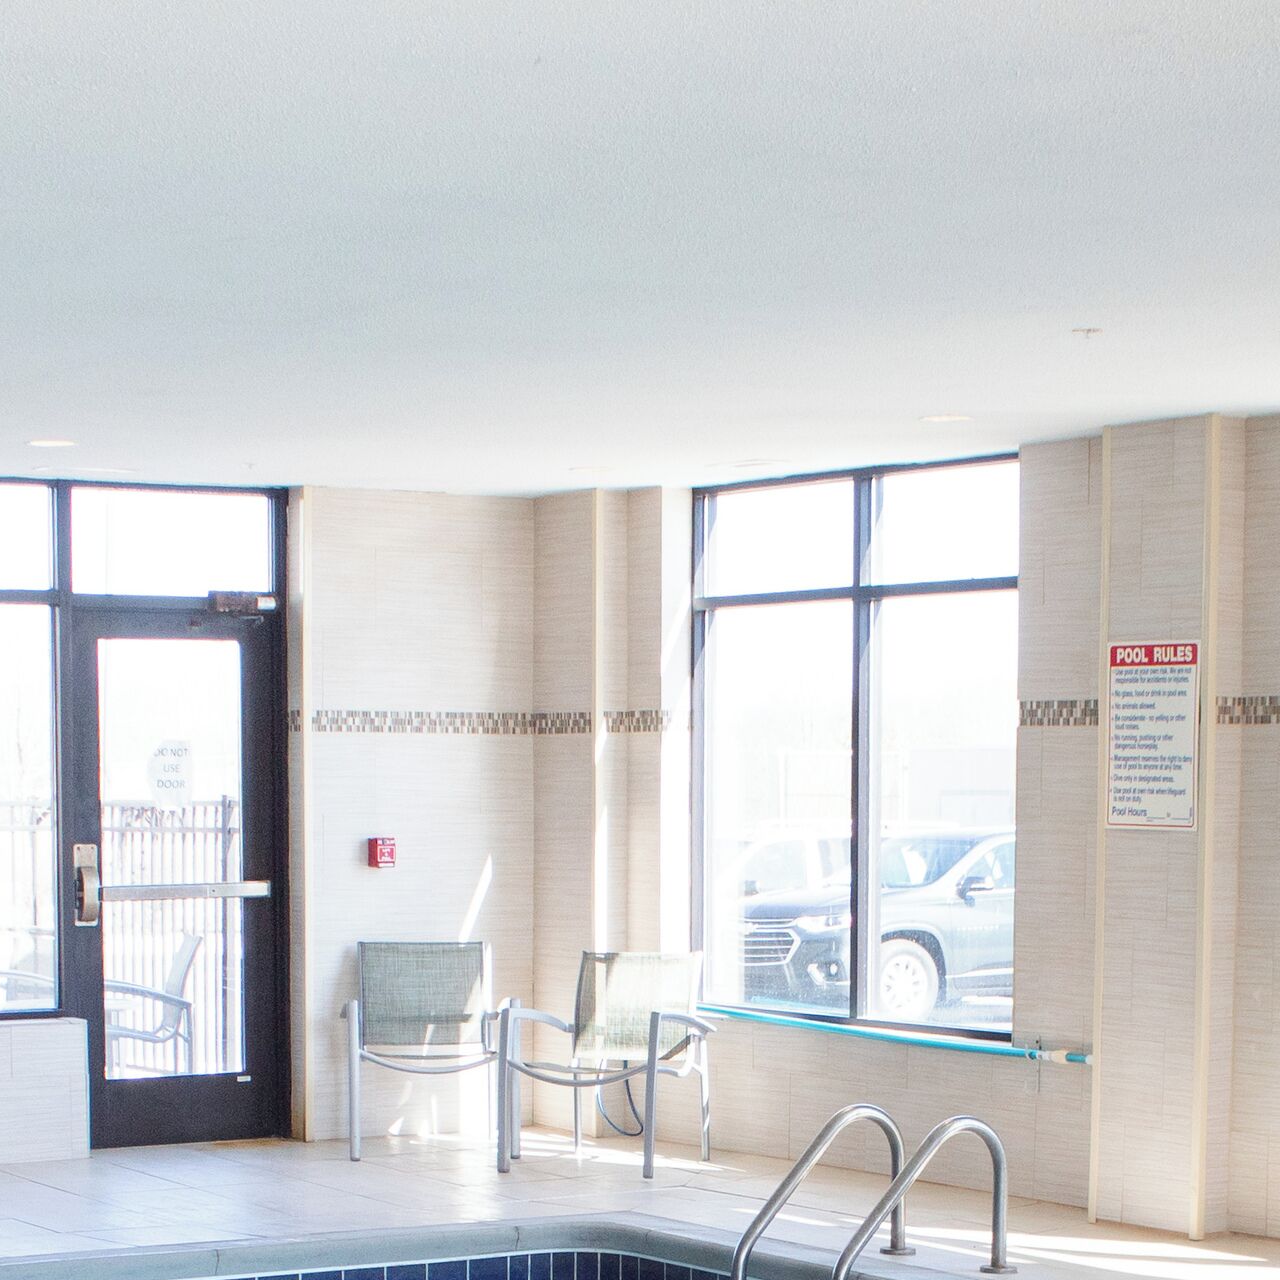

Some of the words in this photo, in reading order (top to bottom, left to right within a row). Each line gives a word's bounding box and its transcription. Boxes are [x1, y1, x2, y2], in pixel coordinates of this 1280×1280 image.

[1116, 648, 1148, 663] POOL
[1153, 646, 1193, 662] RULES
[170, 747, 191, 757] NOT
[163, 763, 181, 773] USE
[156, 779, 186, 789] DOOR
[1112, 806, 1127, 815] Pool
[1127, 807, 1147, 816] Hours
